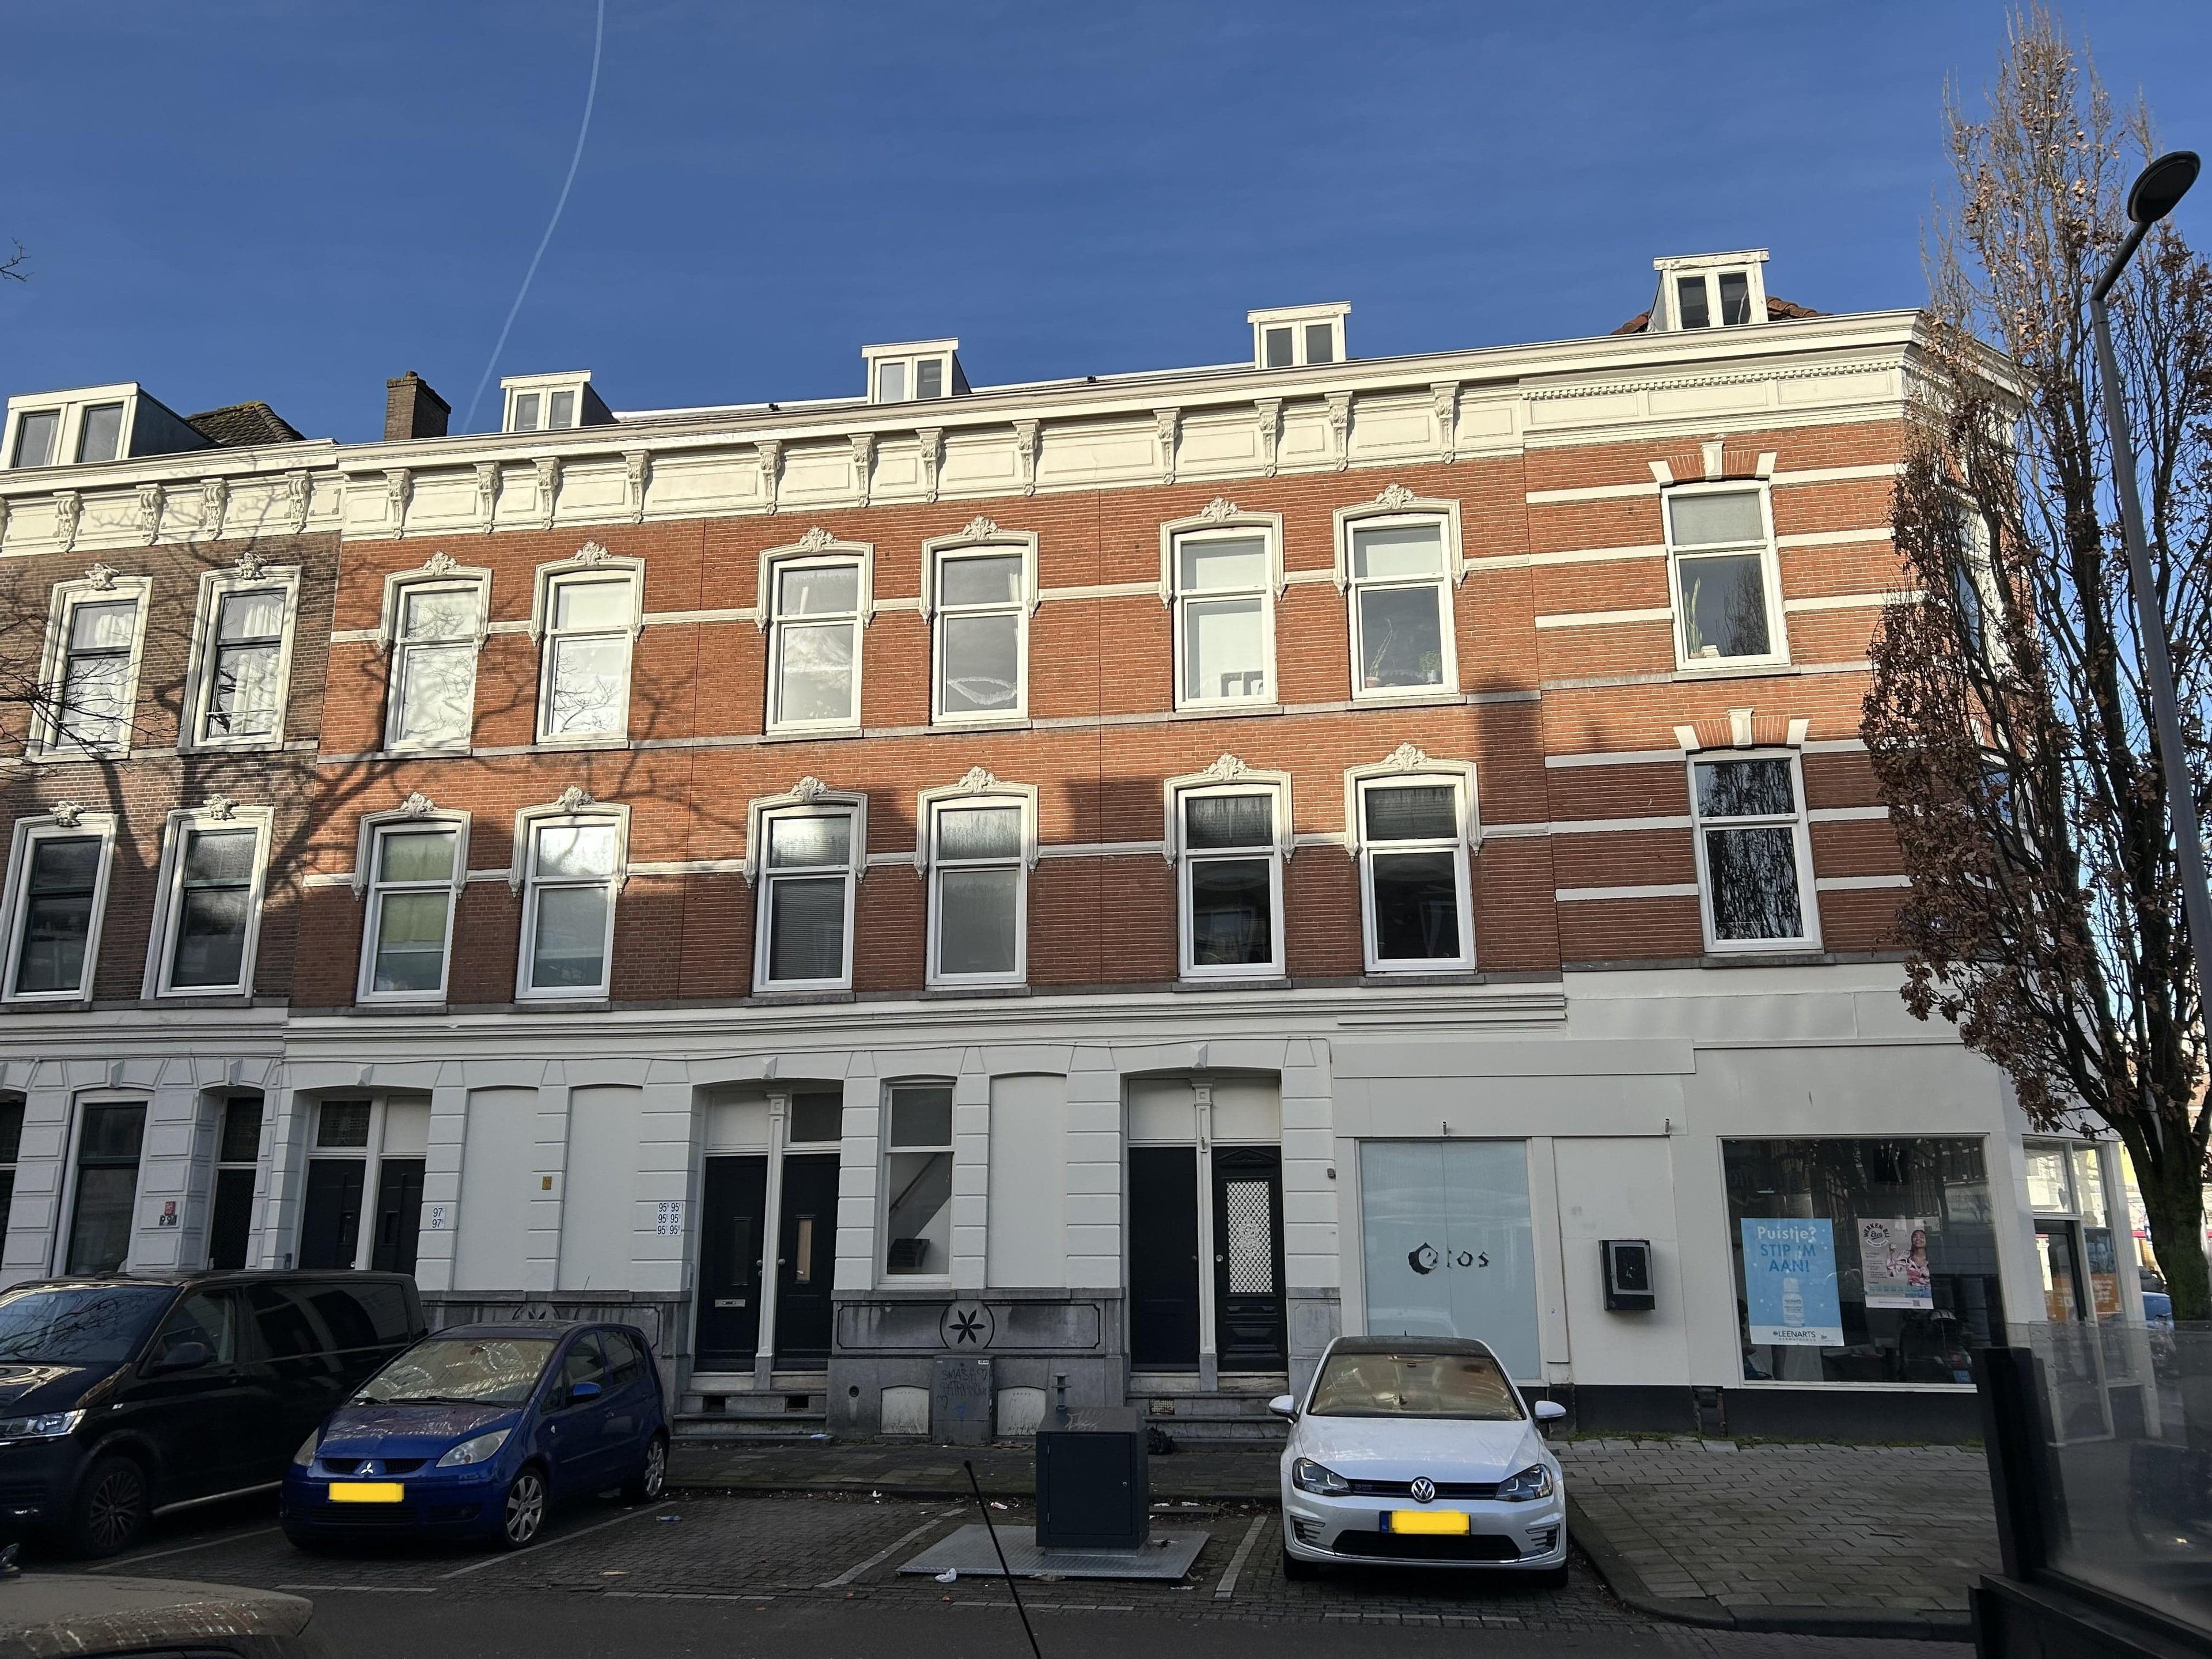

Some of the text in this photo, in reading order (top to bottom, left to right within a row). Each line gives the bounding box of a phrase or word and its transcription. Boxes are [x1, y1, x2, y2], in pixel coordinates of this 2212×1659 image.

[1758, 1225, 1816, 1243] Puistje?
[1863, 1222, 1884, 1237] WERKEN
[1760, 1244, 1790, 1256] STIP
[1769, 1259, 1810, 1272] AAN!
[941, 1368, 977, 1381] SMASH
